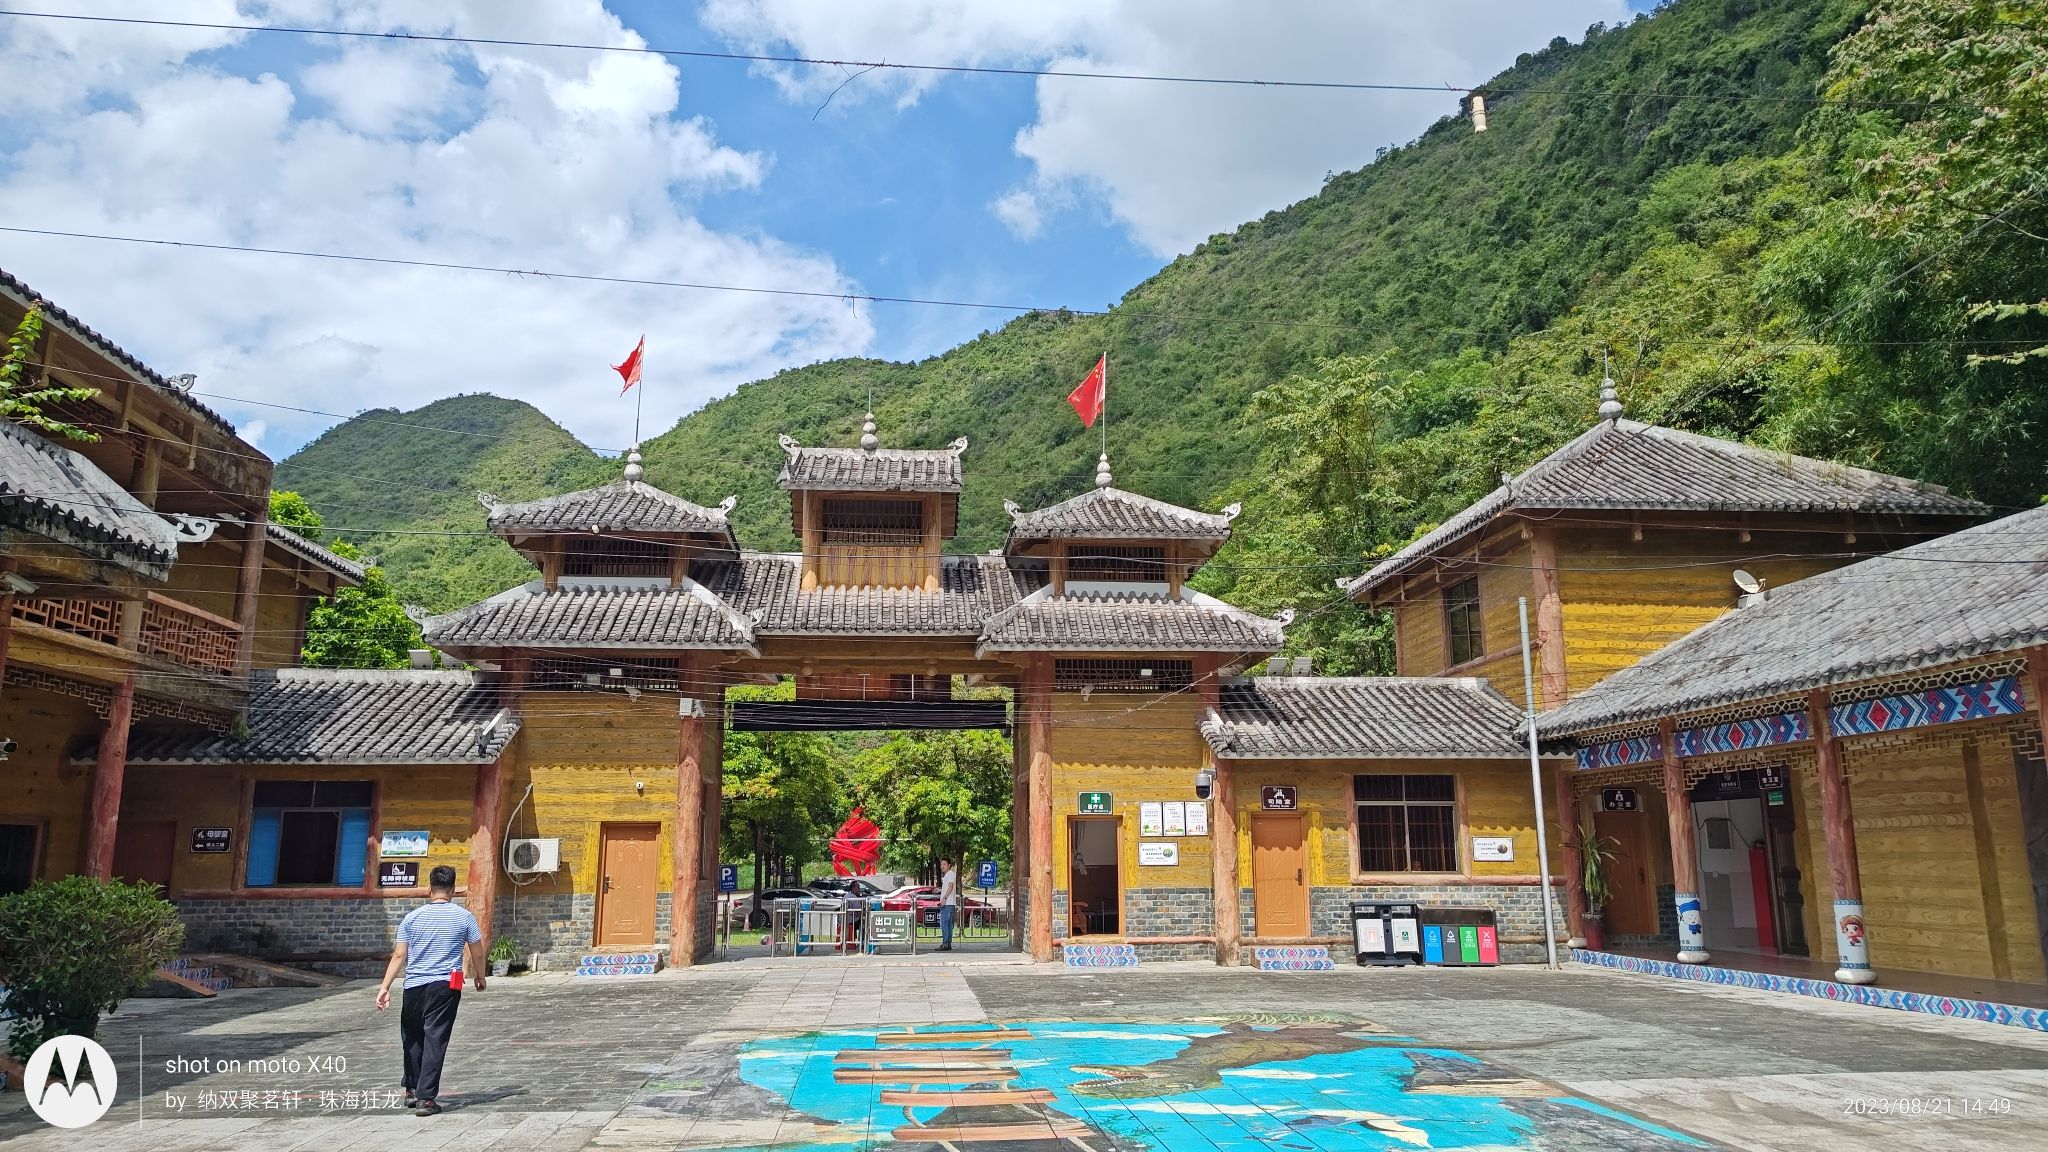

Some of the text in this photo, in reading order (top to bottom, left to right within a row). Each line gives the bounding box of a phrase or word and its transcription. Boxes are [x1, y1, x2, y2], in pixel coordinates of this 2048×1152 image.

[207, 830, 229, 838] 母婴室
[721, 867, 732, 881] P
[982, 863, 992, 877] P
[875, 916, 892, 926] 出口
